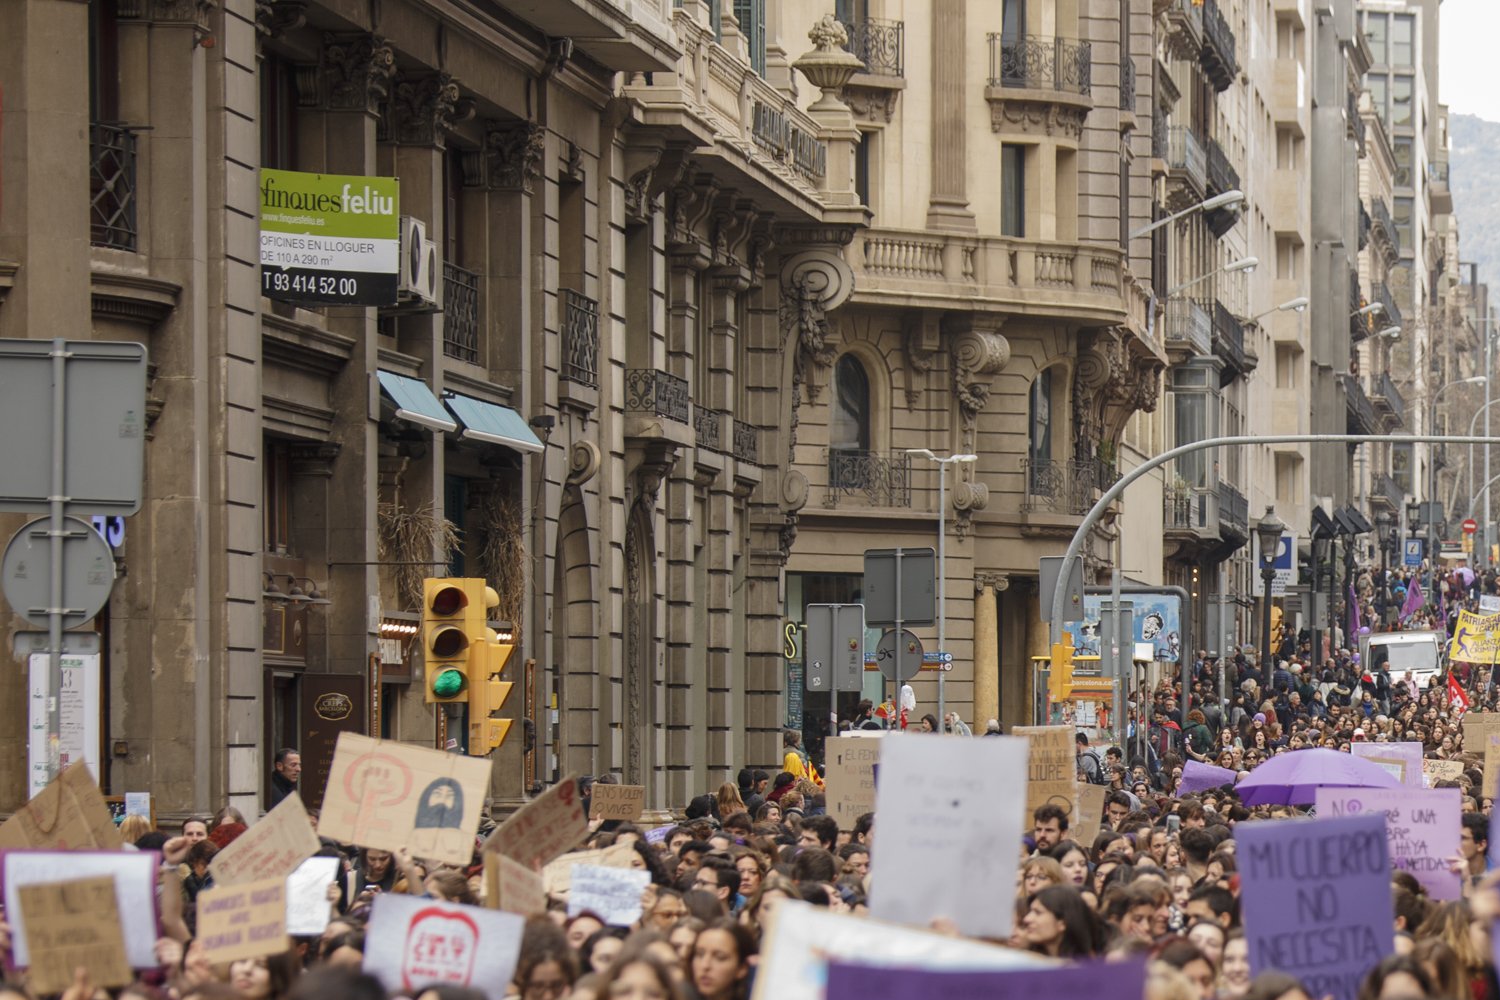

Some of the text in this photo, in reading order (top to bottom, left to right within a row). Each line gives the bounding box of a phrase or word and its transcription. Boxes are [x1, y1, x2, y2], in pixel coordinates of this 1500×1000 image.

[261, 235, 375, 254] OFICINES EN LLOGUER
[261, 250, 274, 261] DE
[277, 252, 291, 263] 110
[294, 254, 300, 264] A
[302, 254, 318, 265] 290
[263, 272, 357, 296] T 93 414 52 00
[1029, 764, 1067, 781] LIURE
[594, 786, 644, 800] ENS VOLEM
[606, 803, 634, 815] VIVES
[1411, 809, 1437, 824] UNA
[1249, 830, 1385, 880] MI CUERPO
[1395, 841, 1428, 856] HAYA
[1296, 883, 1338, 924] NO
[1256, 924, 1382, 970] NECESITA
